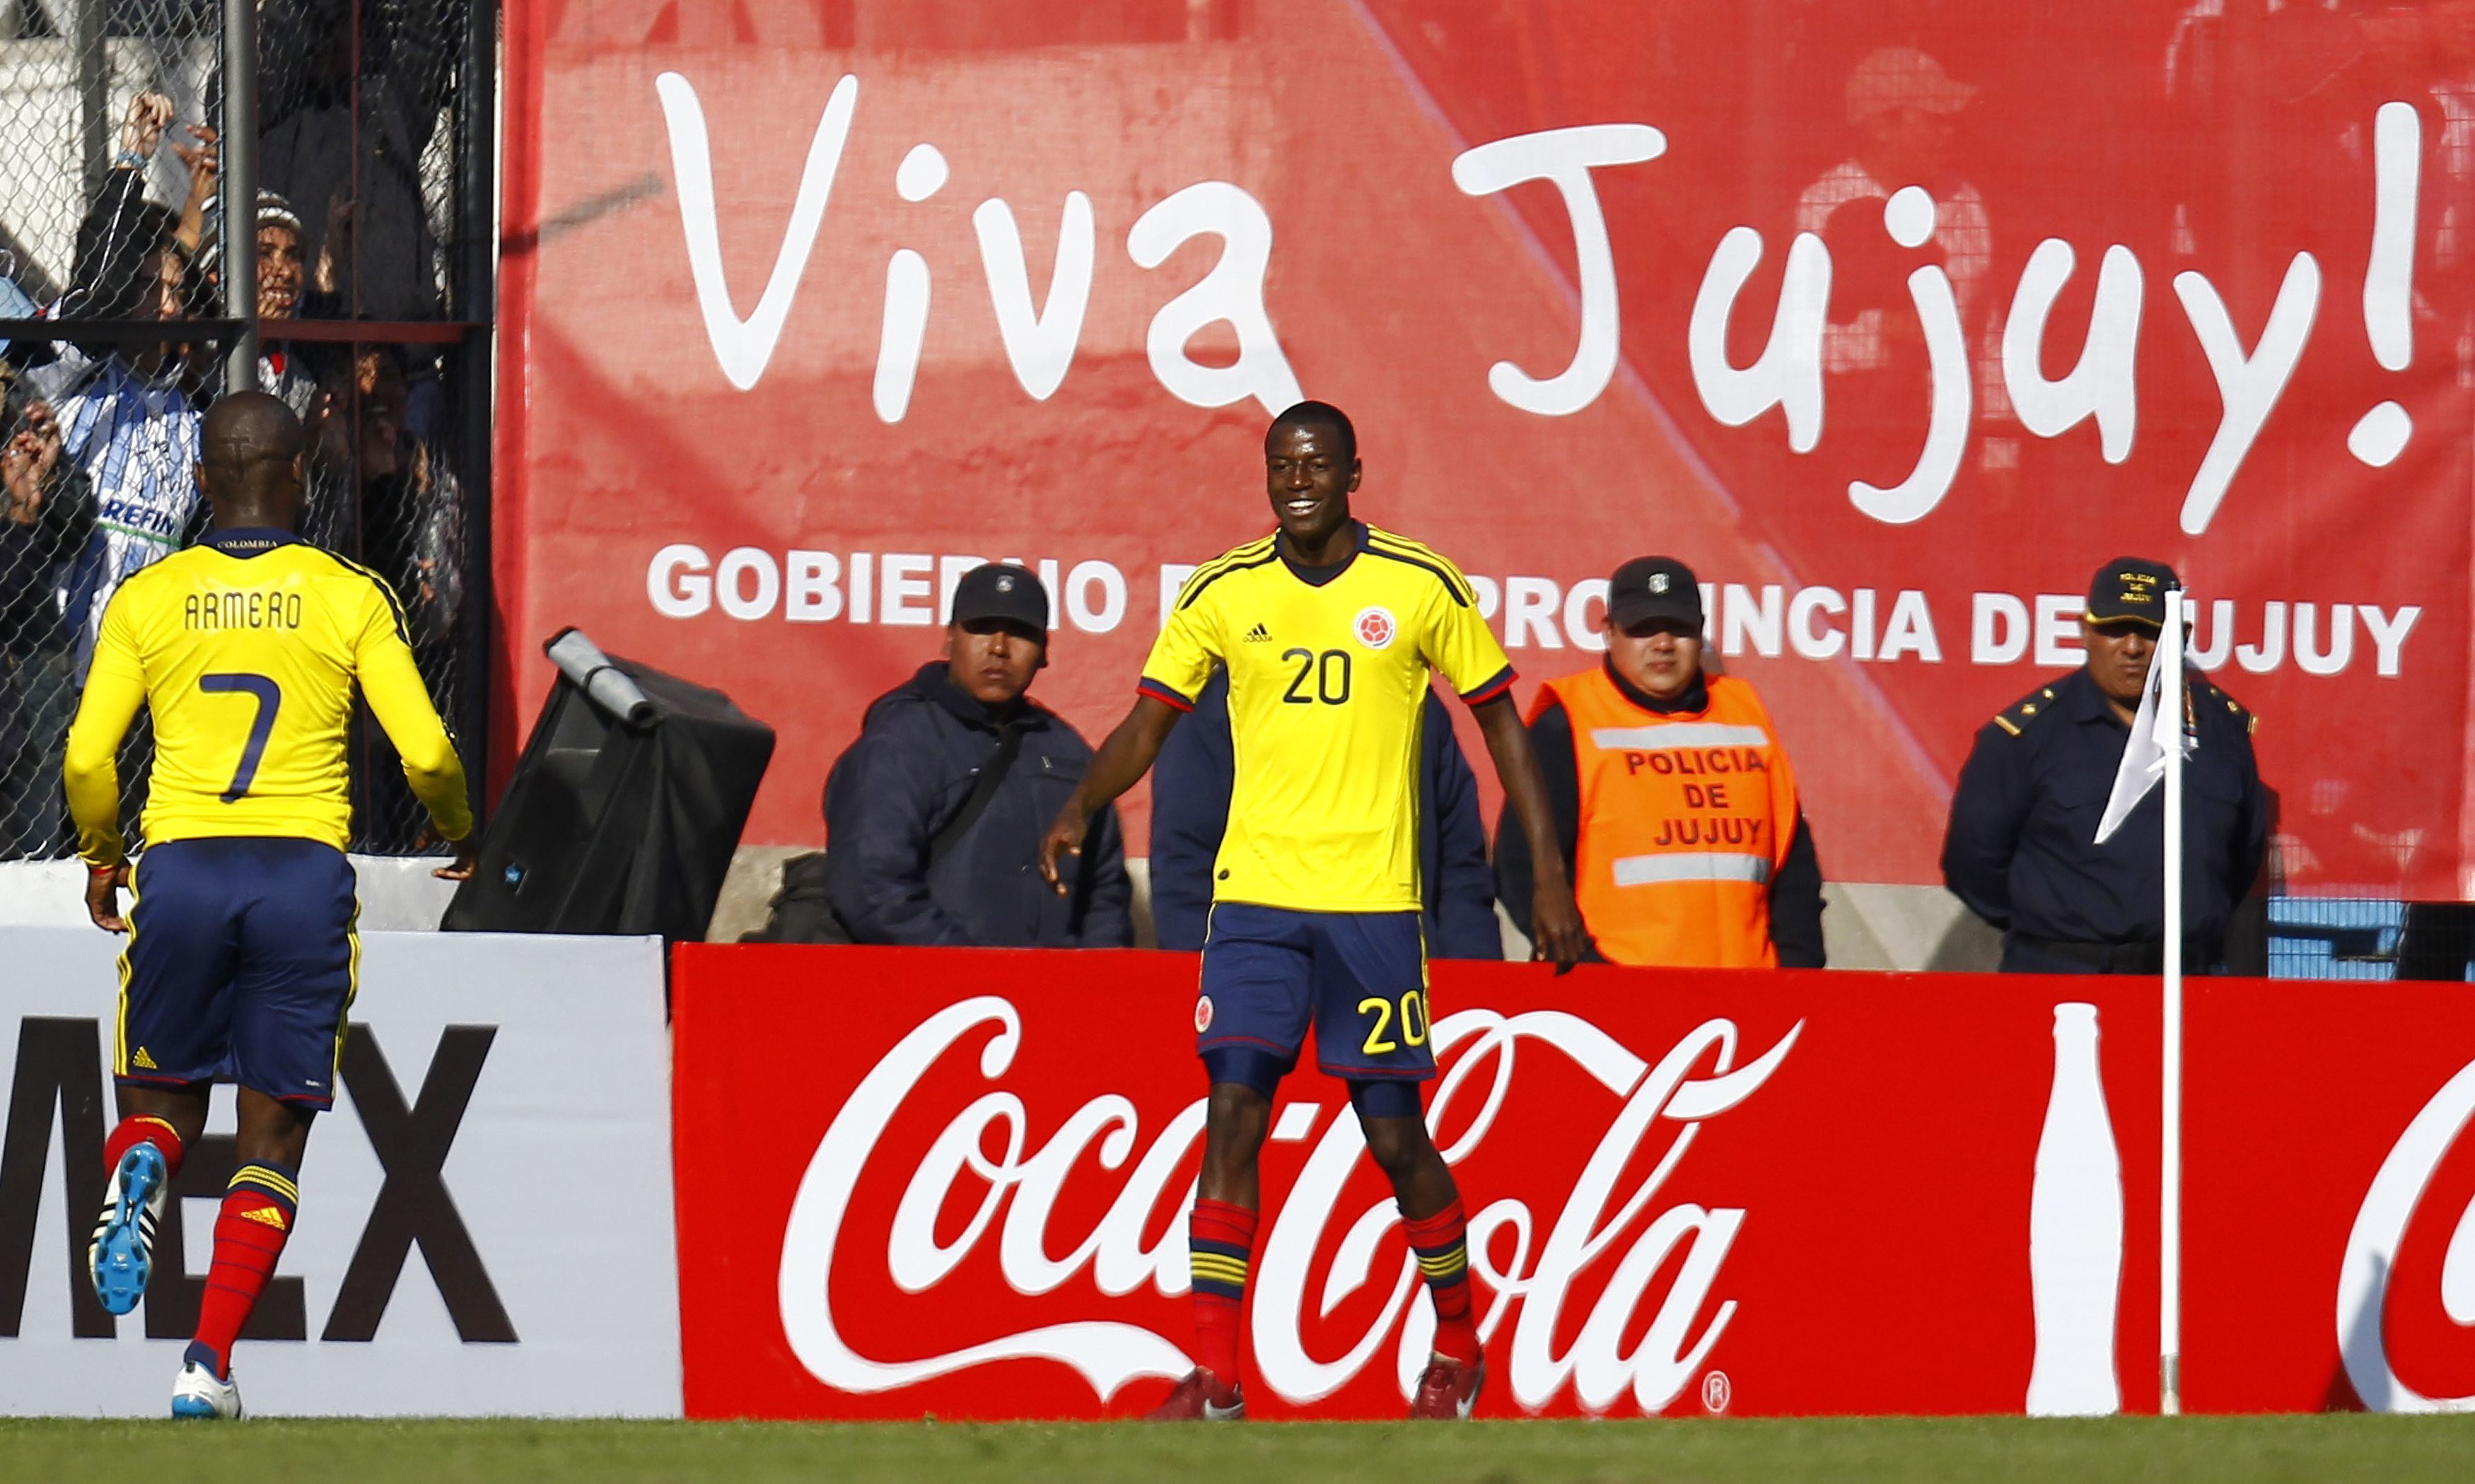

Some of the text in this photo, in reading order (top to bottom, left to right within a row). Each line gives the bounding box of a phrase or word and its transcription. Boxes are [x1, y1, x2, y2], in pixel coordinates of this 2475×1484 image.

[656, 71, 2421, 535] Viva Jujuy!
[216, 539, 278, 549] COLOMBIA
[185, 592, 301, 629] ARMERO
[1972, 592, 2088, 667] DE
[2182, 598, 2421, 677] UJUY
[1281, 648, 1351, 704] 20
[199, 672, 281, 804] 7
[1626, 749, 1767, 775] POLICIA
[1683, 783, 1728, 810] DE
[1655, 817, 1764, 846] JUJUY
[1358, 991, 1426, 1054] 20
[778, 995, 1805, 1413] Coca-Cola
